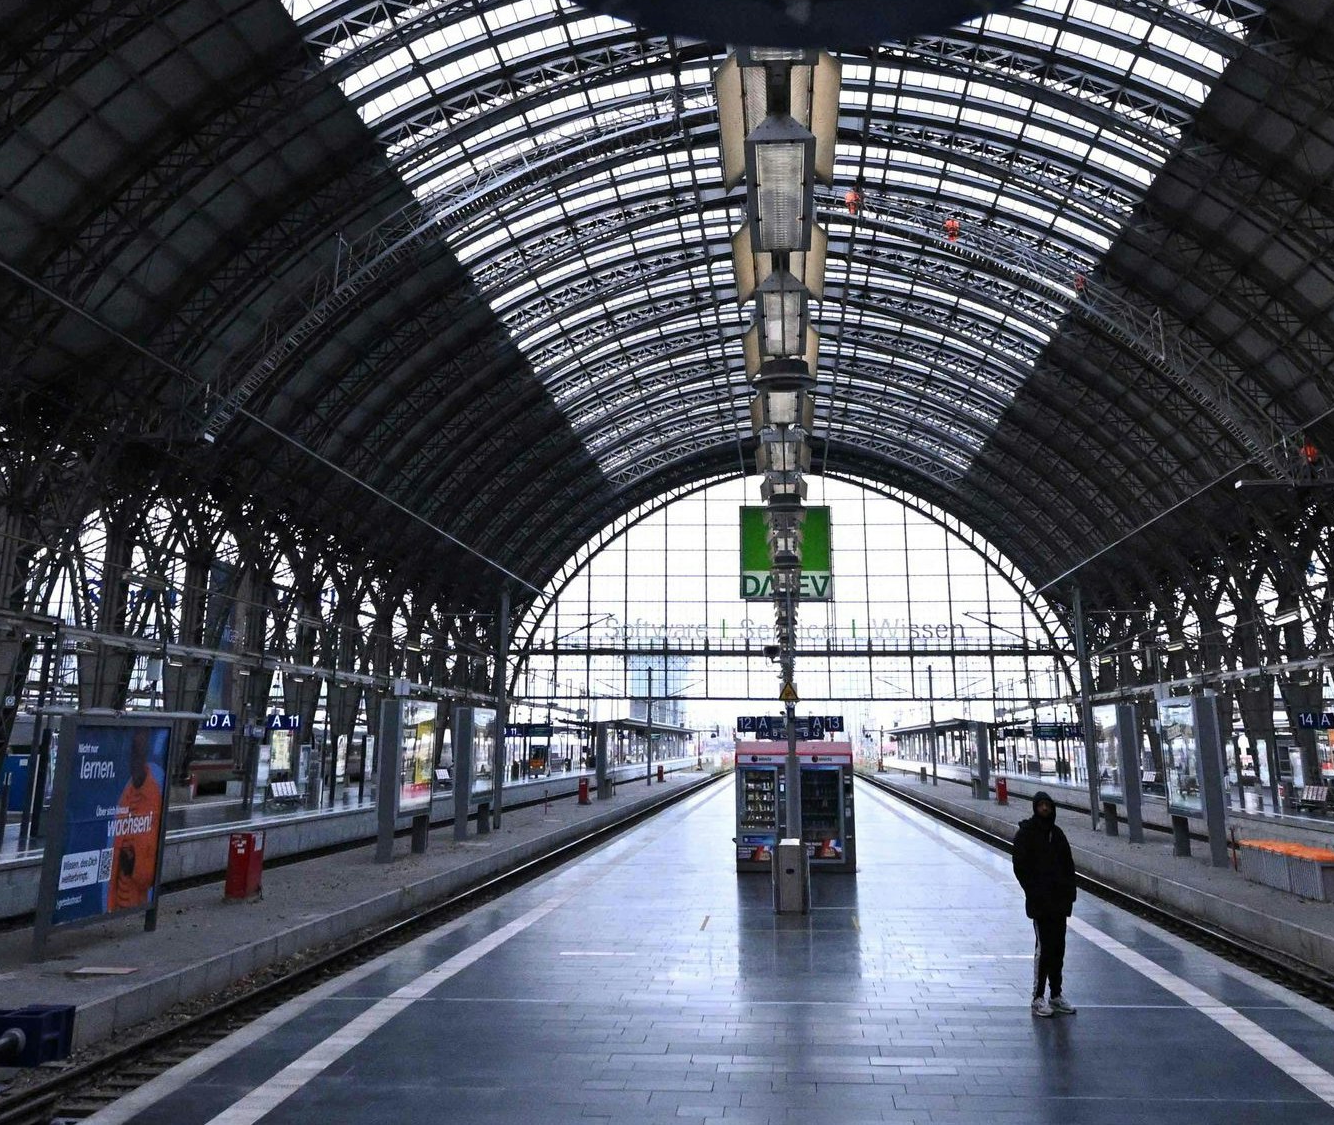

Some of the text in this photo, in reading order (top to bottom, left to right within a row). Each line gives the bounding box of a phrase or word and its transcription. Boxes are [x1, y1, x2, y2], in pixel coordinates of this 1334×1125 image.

[742, 575, 830, 597] DAEV
[605, 618, 966, 641] Software Serice Wissen
[221, 715, 231, 727] A
[272, 715, 299, 727] A 11
[738, 717, 768, 729] 12 A
[812, 717, 840, 729] A 13
[1299, 713, 1331, 726] 14 A
[80, 755, 116, 779] lernen.
[107, 811, 154, 837] wachsen!
